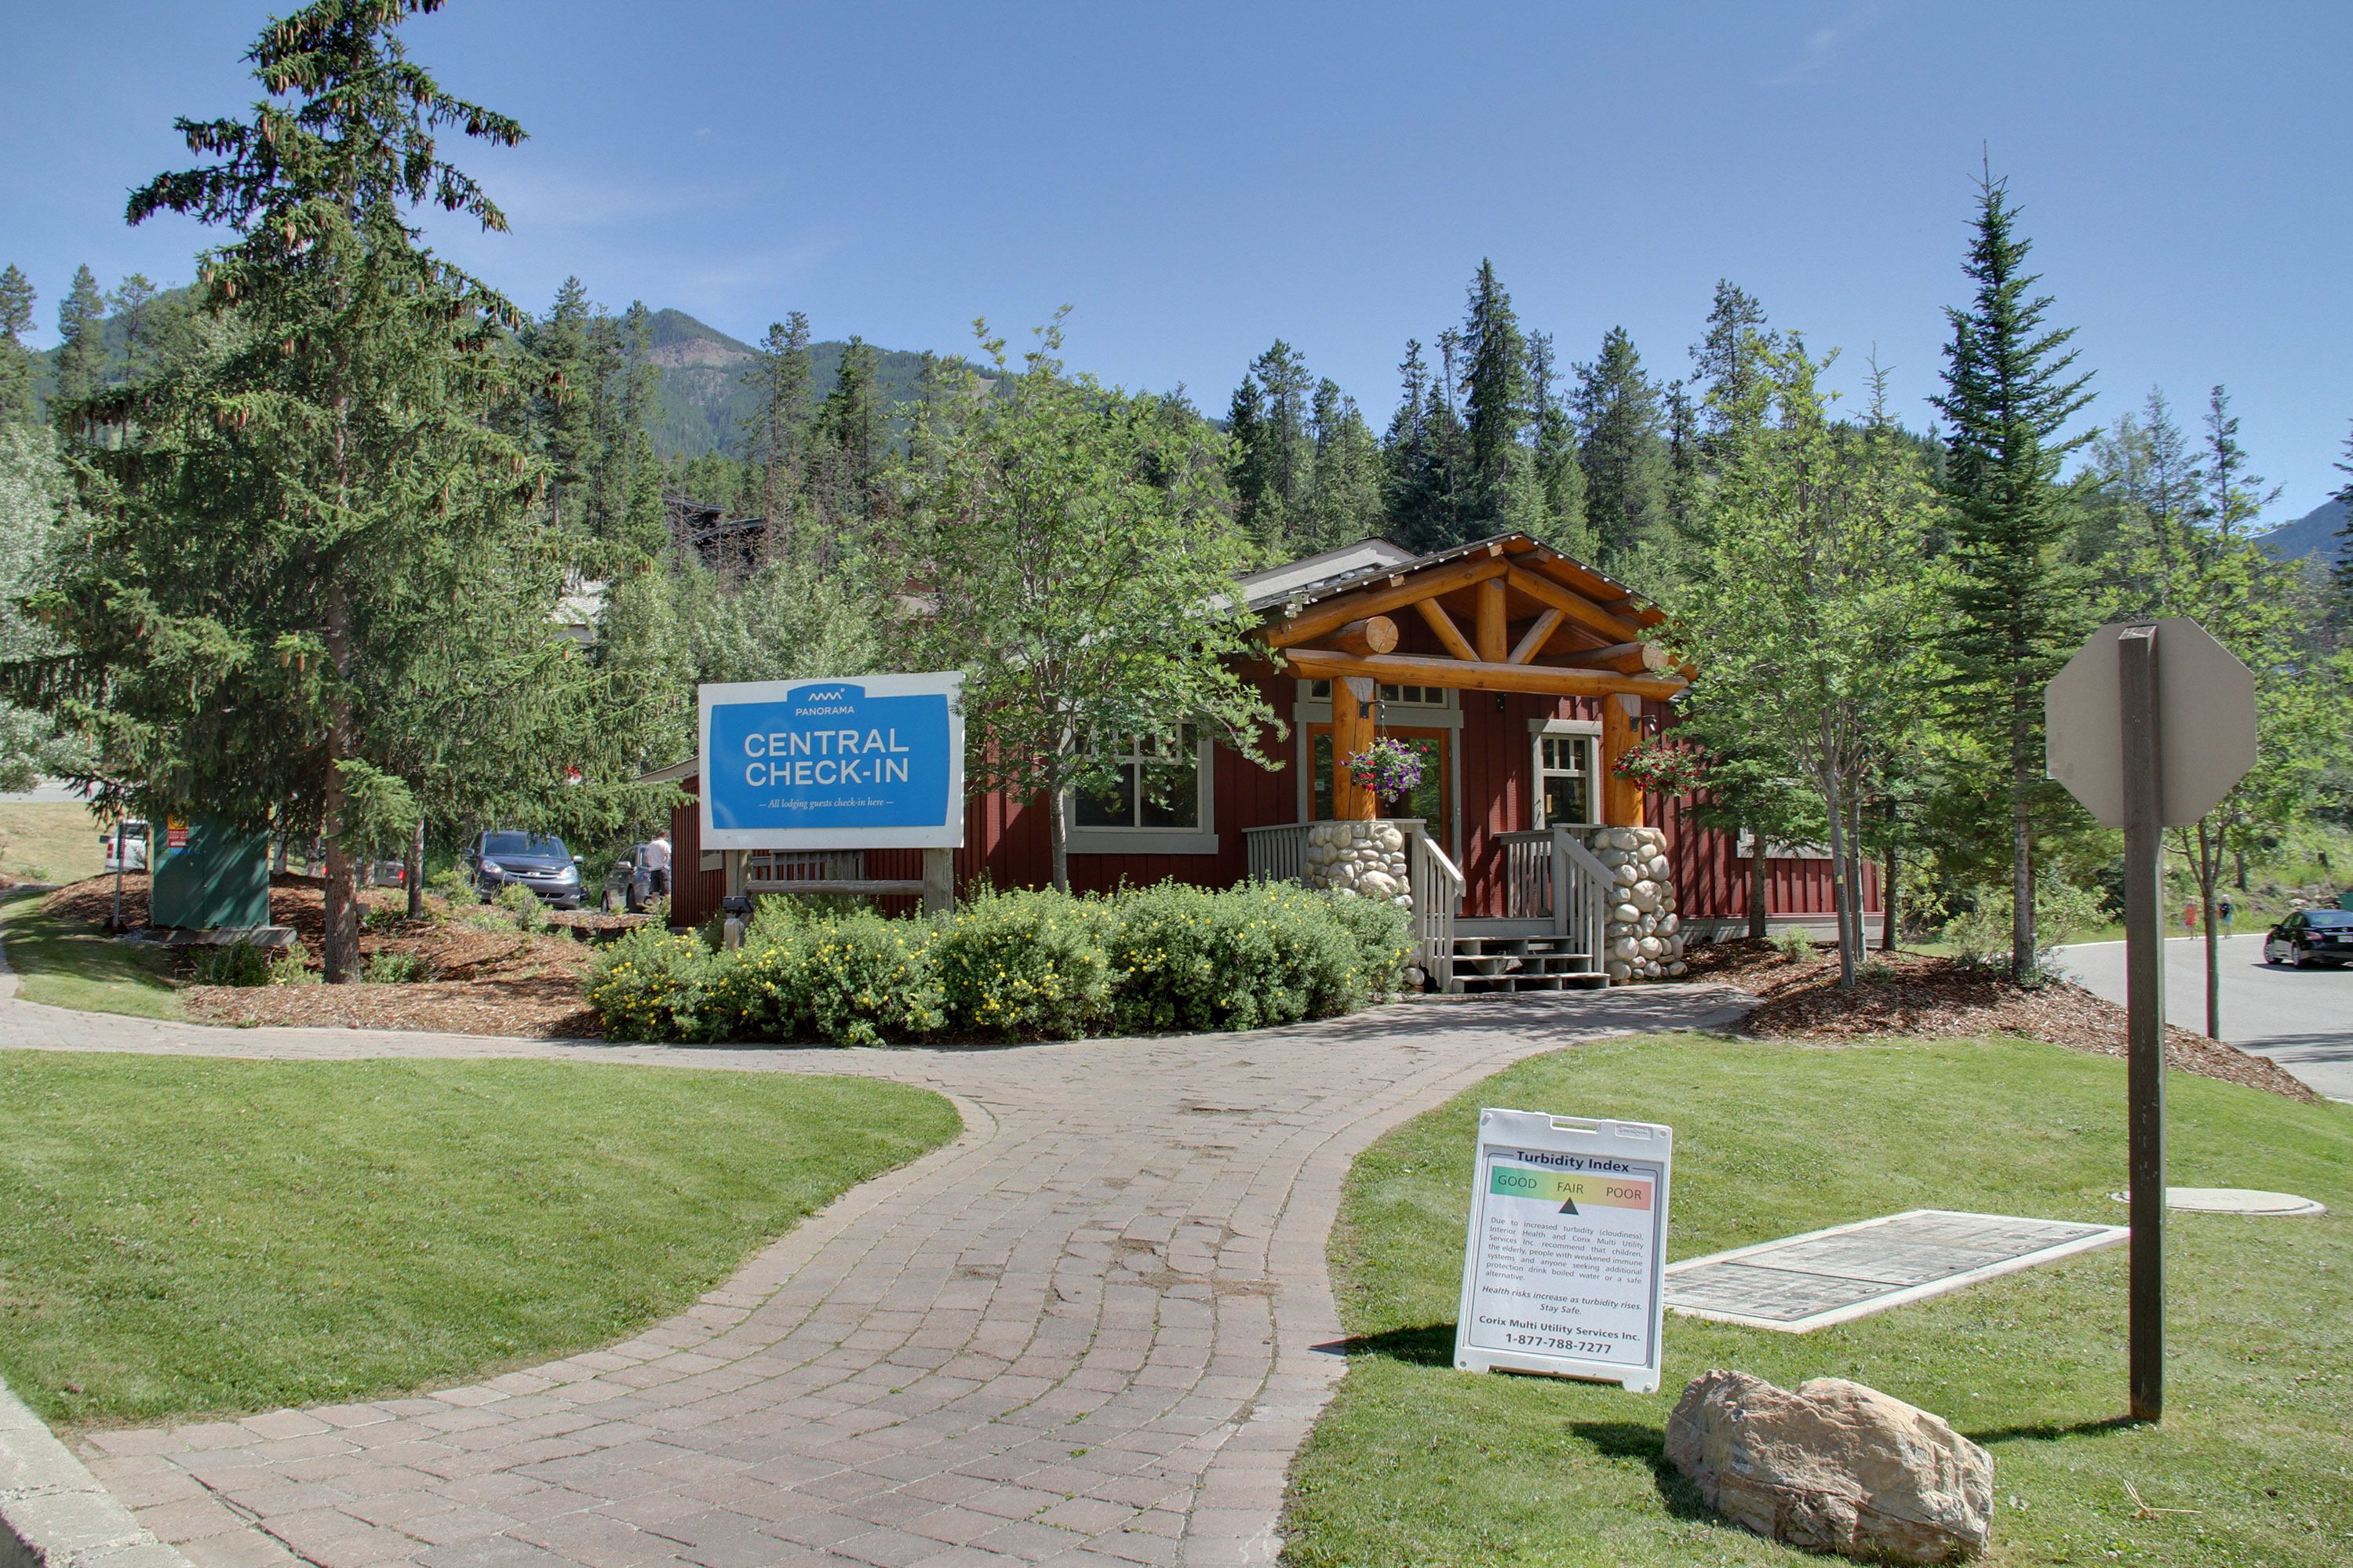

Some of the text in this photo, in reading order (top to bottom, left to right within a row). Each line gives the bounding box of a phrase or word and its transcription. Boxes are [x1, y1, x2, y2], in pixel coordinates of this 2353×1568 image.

[796, 706, 855, 716] PANORAMA
[744, 728, 909, 758] CENTRAL
[745, 758, 909, 787] CHECK-IN
[768, 797, 884, 810] All lodging guests check-in here
[1517, 1151, 1630, 1172] Turbidity Index
[1498, 1175, 1642, 1200] GOOD FAIR POOR
[1490, 1226, 1516, 1235] Interior
[1522, 1230, 1546, 1239] Health
[1572, 1235, 1590, 1243] Corix
[1597, 1238, 1616, 1246] Multi
[1623, 1240, 1645, 1250] Utility
[1524, 1221, 1557, 1231] increased
[1563, 1225, 1594, 1235] turbidity
[1599, 1229, 1645, 1241] (cloudiness),
[1489, 1235, 1517, 1244] Services
[1542, 1241, 1585, 1252] recommend
[1612, 1249, 1643, 1258] children,
[1502, 1245, 1527, 1255] elderly,
[1529, 1249, 1554, 1257] people
[1574, 1253, 1611, 1264] weakened
[1612, 1257, 1643, 1266] immune
[1486, 1261, 1524, 1272] protection
[1528, 1265, 1547, 1274] drink
[1551, 1268, 1575, 1277] boiled
[1487, 1253, 1515, 1262] systems
[1540, 1259, 1567, 1268] anyone
[1572, 1262, 1600, 1272] seeking
[1605, 1265, 1642, 1275] additional
[1485, 1270, 1525, 1281] alternative.
[1482, 1285, 1510, 1296] Health
[1533, 1293, 1568, 1302] increase
[1582, 1297, 1619, 1309] turbidity
[1621, 1302, 1642, 1311] rises.
[1540, 1303, 1583, 1315] Stay Safe.
[1479, 1315, 1641, 1341] Corix Multi Utility Services Inc.
[1506, 1333, 1612, 1354] 1-877-788-7277
